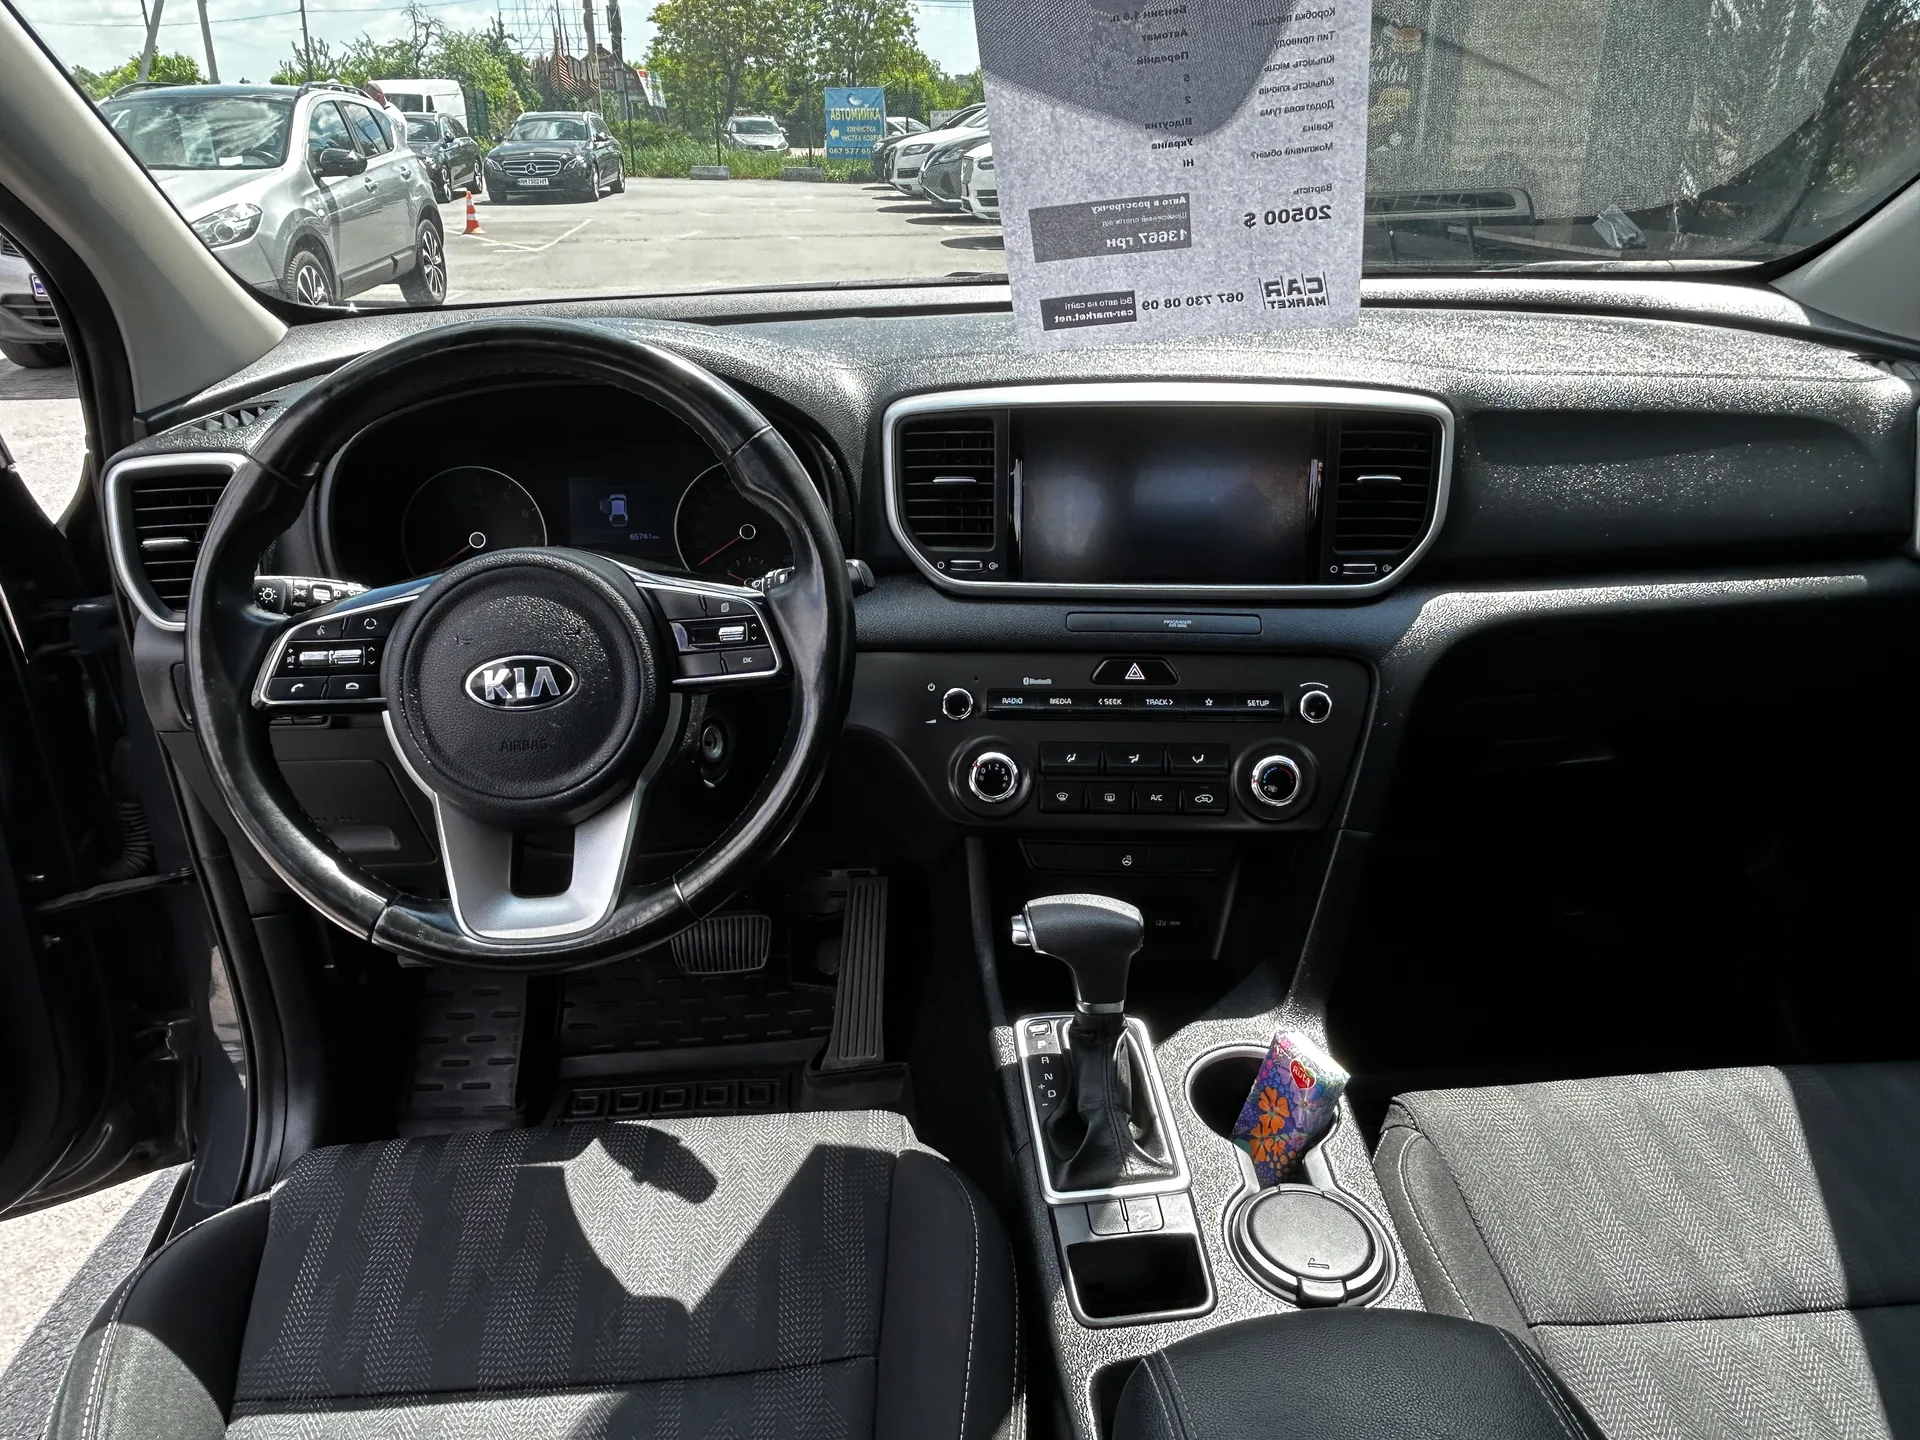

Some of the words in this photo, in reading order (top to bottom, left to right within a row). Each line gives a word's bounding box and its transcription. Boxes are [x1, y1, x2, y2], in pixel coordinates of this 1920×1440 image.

[483, 666, 561, 700] KIA
[1001, 697, 1023, 705] RADIO
[1049, 697, 1072, 705] MEDIA
[1247, 699, 1269, 707] SETUP
[1150, 793, 1163, 802] A/C
[1044, 1073, 1053, 1081] N
[1047, 1089, 1057, 1098] D
